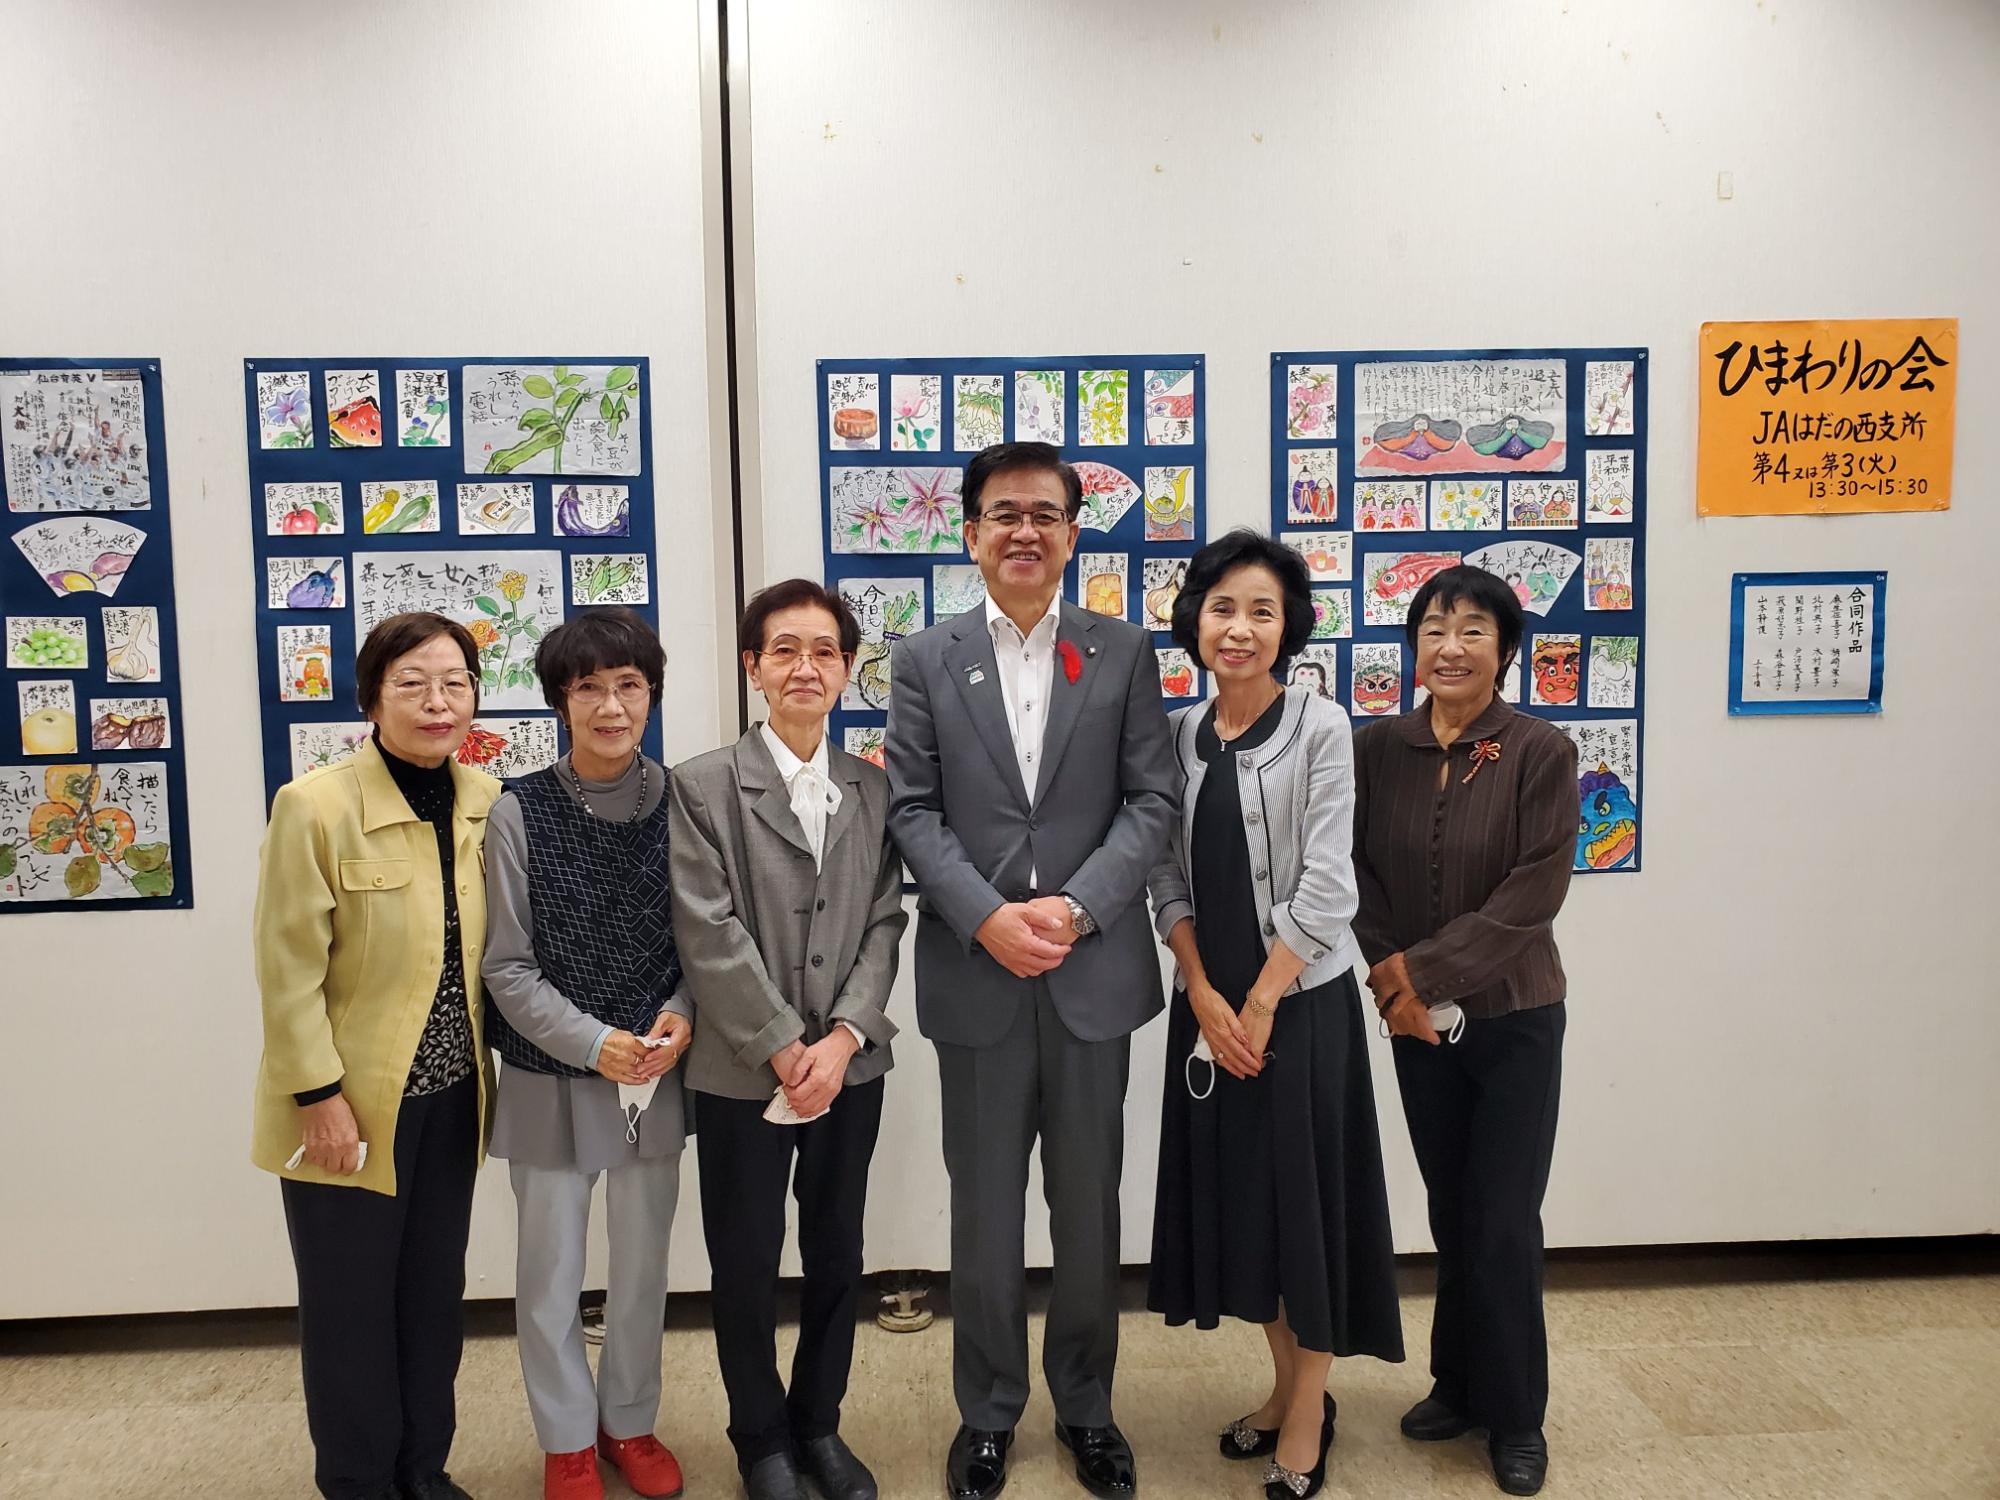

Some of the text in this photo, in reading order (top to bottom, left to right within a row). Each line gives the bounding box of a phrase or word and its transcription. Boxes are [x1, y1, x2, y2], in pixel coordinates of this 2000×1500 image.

[1714, 335, 1950, 397] ひまわりの会
[1751, 410, 1928, 444] JAはだの西支所
[1848, 586, 1867, 654] 合同作品
[14, 770, 38, 813] うれしい
[111, 768, 134, 812] 食べて
[137, 772, 160, 834] 描いたら
